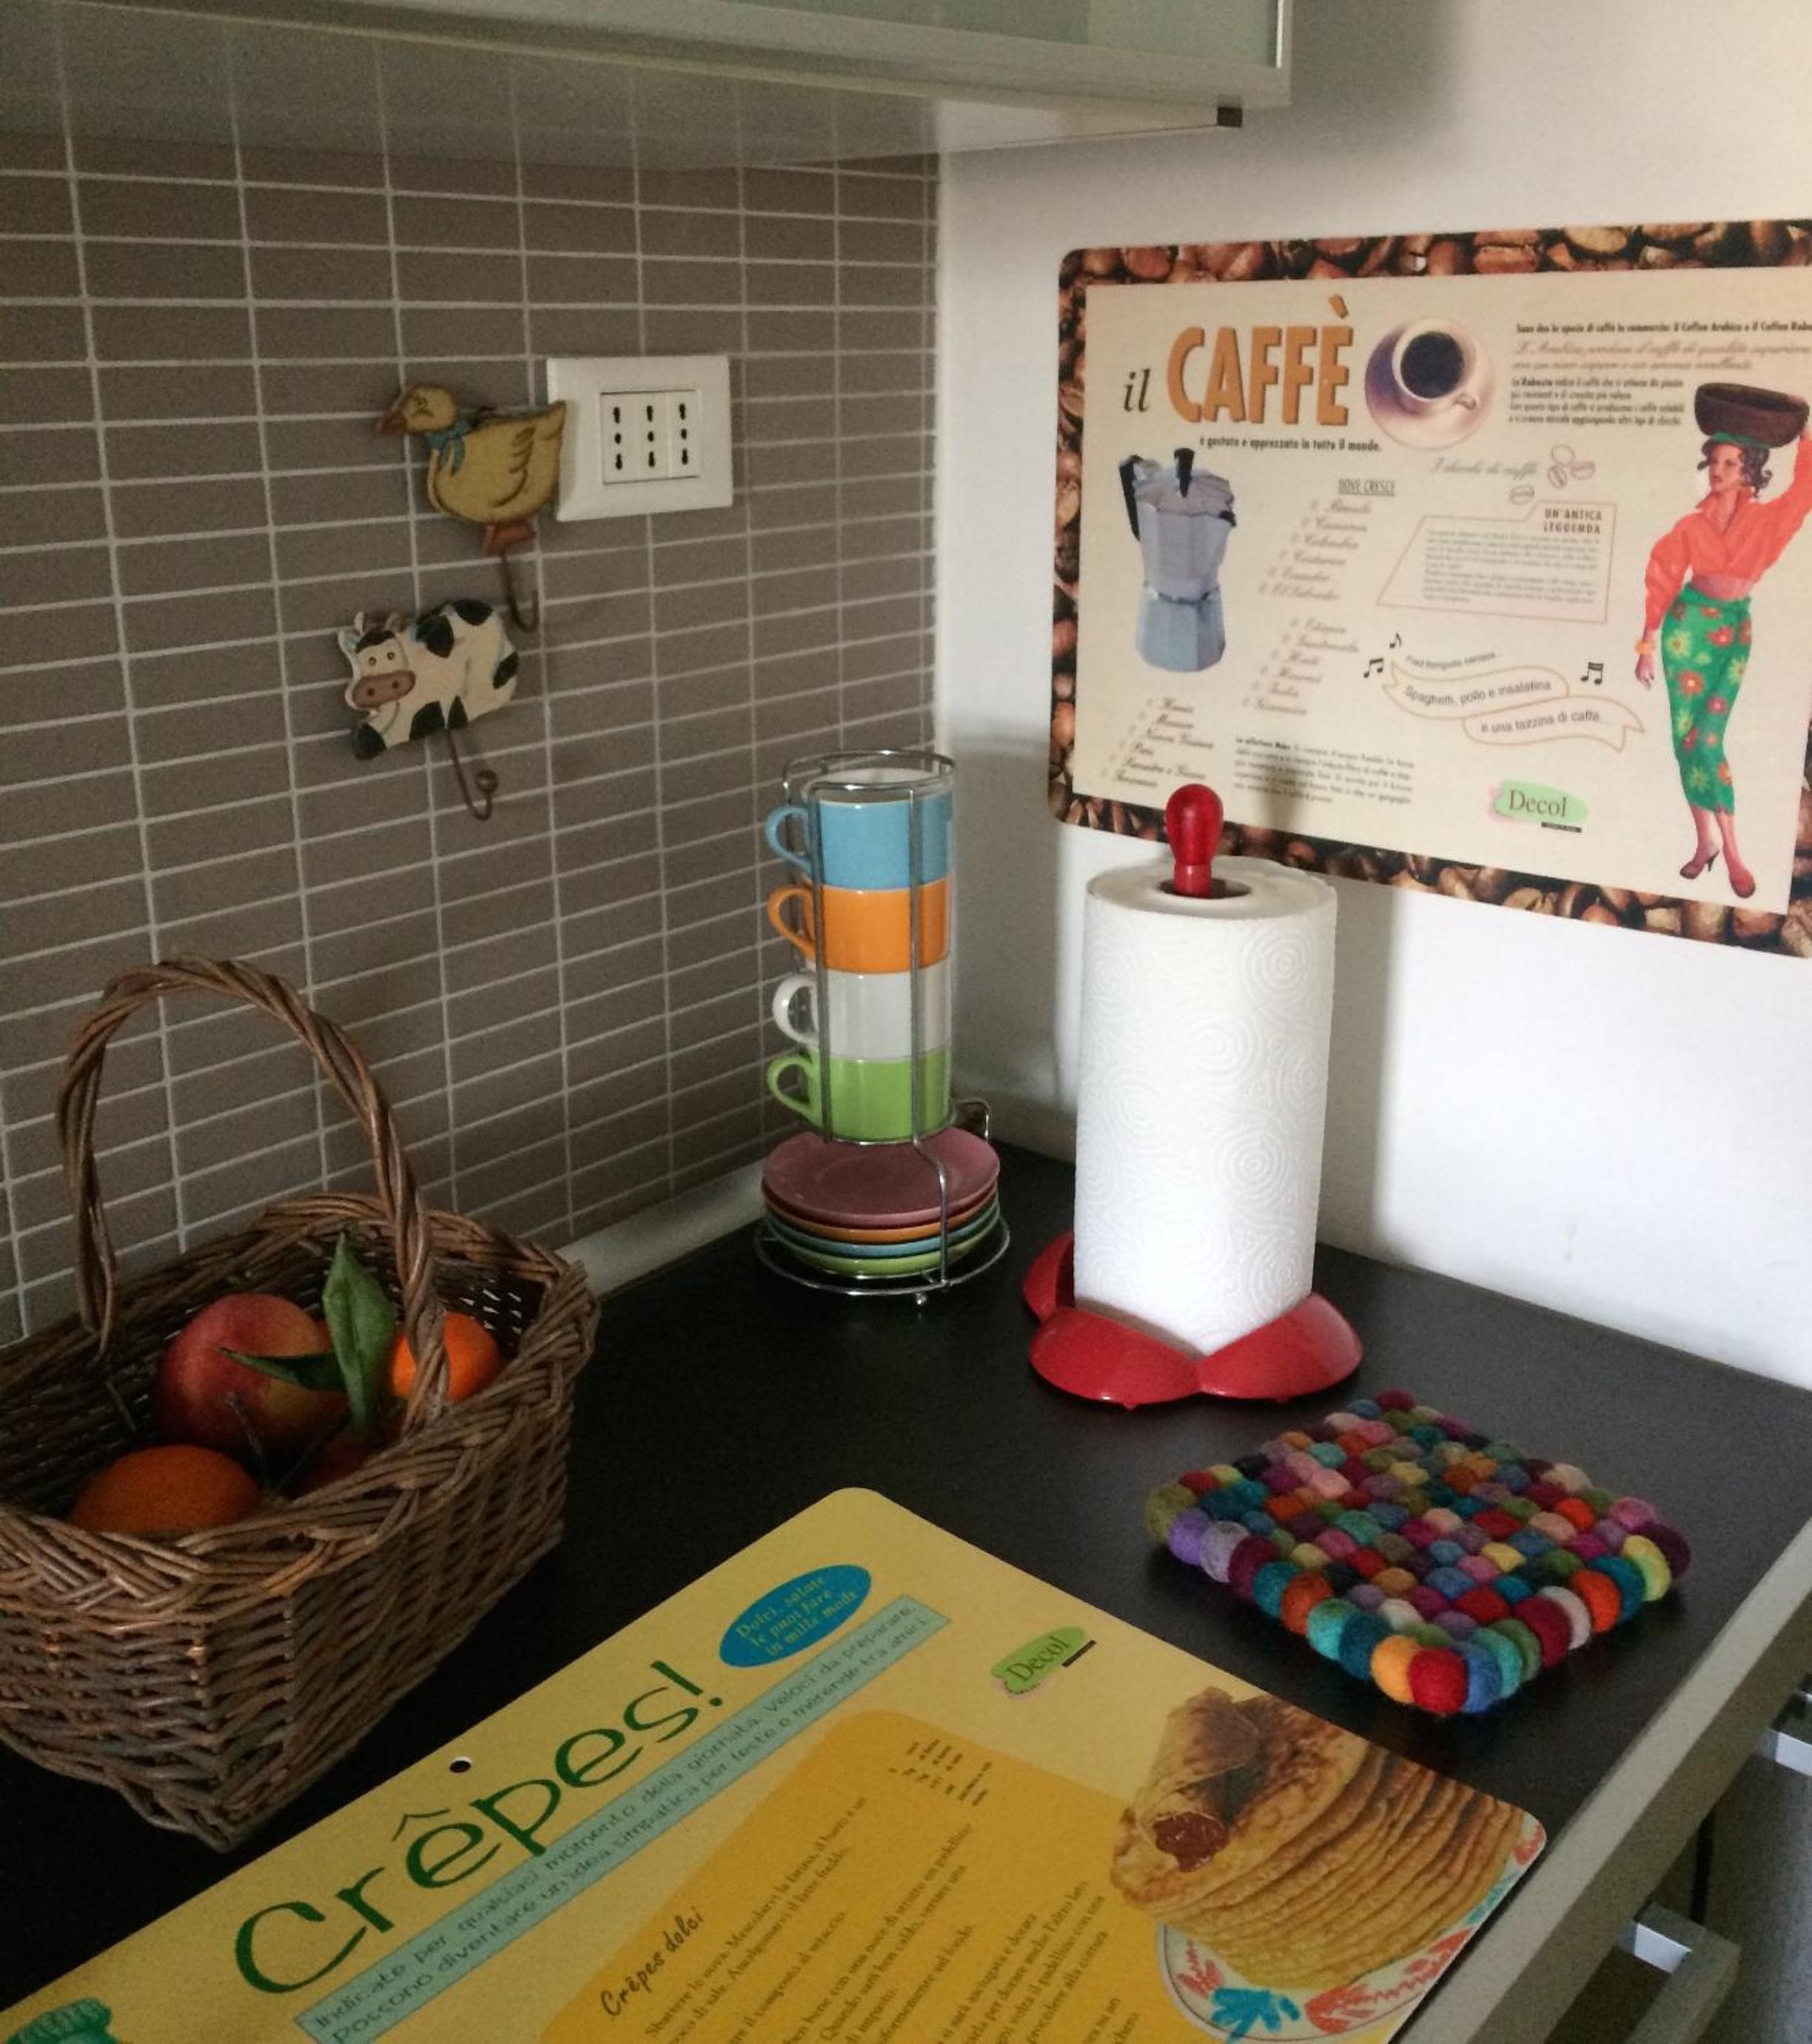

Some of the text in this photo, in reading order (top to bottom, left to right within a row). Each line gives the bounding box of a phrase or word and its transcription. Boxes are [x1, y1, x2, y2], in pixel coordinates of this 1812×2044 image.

[1123, 295, 1353, 426] il CAFFÈ
[1543, 521, 1600, 535] LEGGENDA
[1545, 508, 1602, 520] UN'ANTICA
[1460, 689, 1486, 706] pollo
[1489, 688, 1496, 698] e
[1481, 723, 1489, 733] e
[1491, 721, 1512, 733] una
[1515, 715, 1554, 731] tazzina
[1557, 710, 1568, 723] di
[1509, 789, 1567, 818] Decol
[1005, 1635, 1070, 1681] Decol
[235, 1659, 723, 1995] Crêpes!
[775, 1882, 788, 1892] la
[330, 1972, 437, 2044] Possono
[432, 1900, 537, 1972] diventare
[697, 1763, 731, 1786] per
[593, 1906, 707, 2020] Crêpes dolci
[311, 1963, 409, 2028] Indicate
[412, 1936, 453, 1963] per
[742, 2017, 754, 2026] il
[819, 1994, 862, 2042] Quando
[964, 2020, 987, 2044] arla
